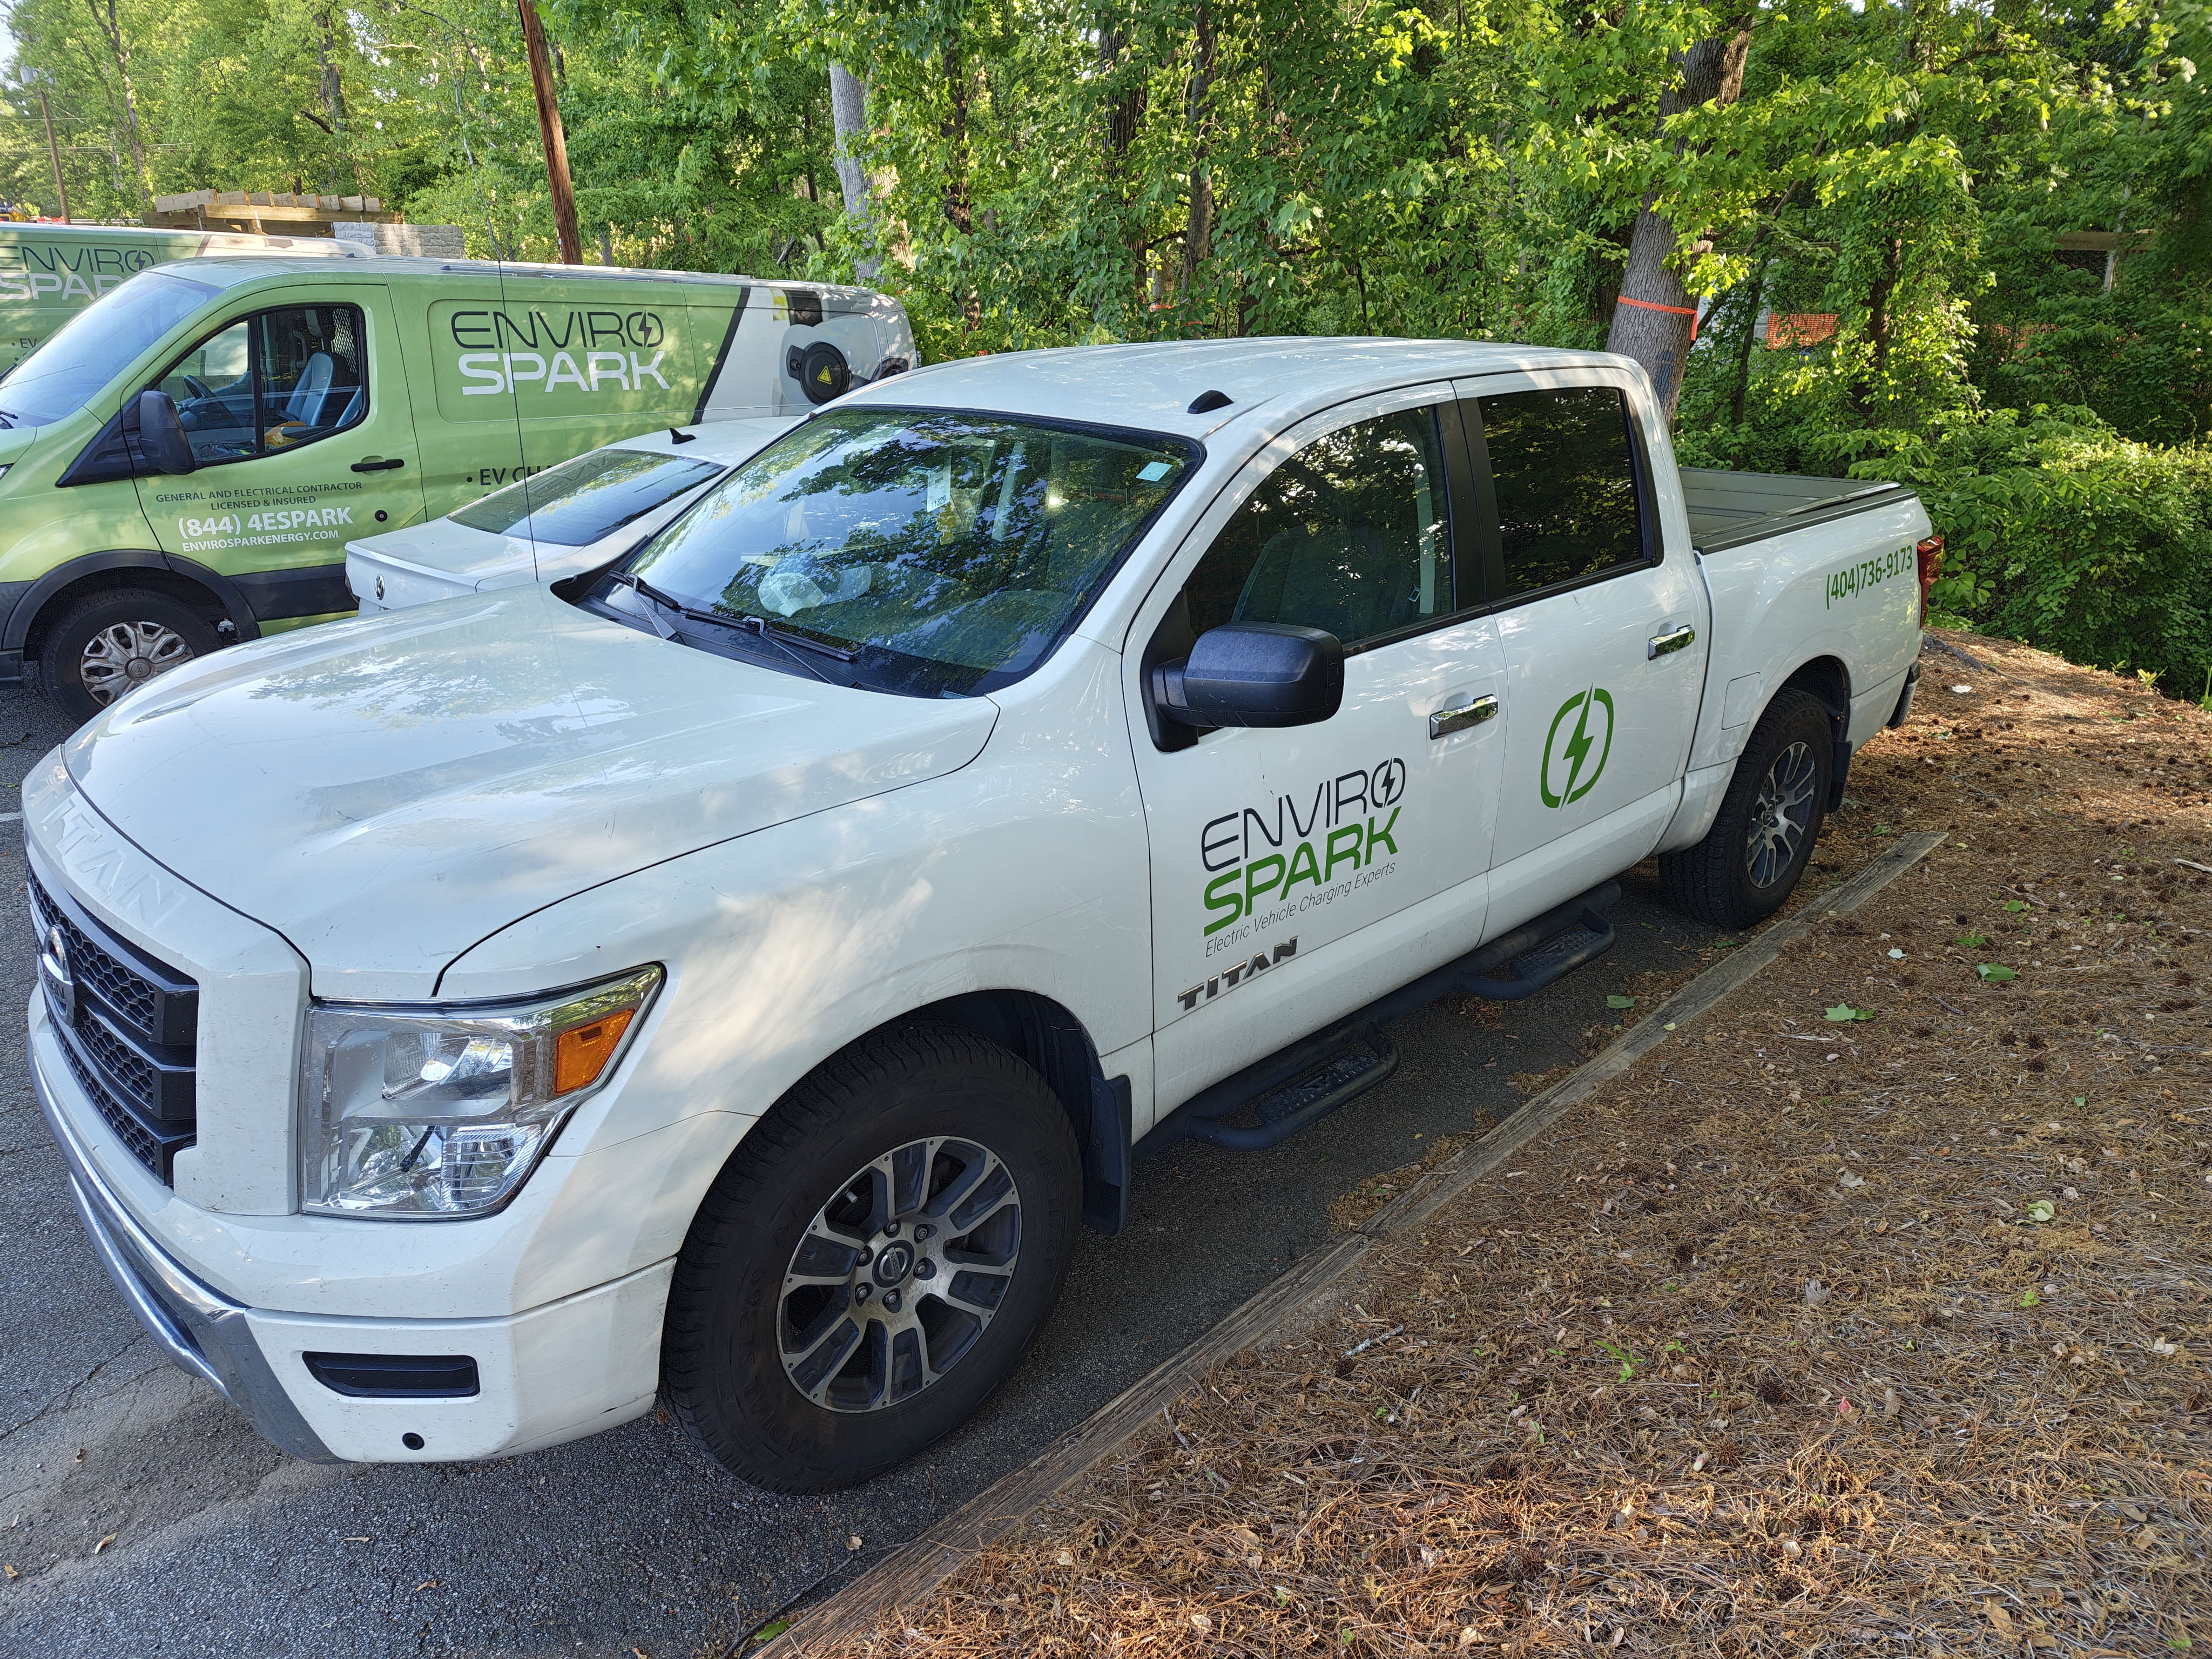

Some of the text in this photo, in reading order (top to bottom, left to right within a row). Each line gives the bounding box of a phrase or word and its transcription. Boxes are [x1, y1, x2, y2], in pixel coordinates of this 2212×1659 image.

[451, 309, 664, 349] ENVIRO
[458, 350, 671, 396] SPARK
[156, 481, 362, 503] GENERAL AND ELECTRICAL CONTRACTOR
[480, 468, 507, 486] EV
[211, 495, 316, 510] LICENSED & INSURED
[931, 495, 946, 509] 11329
[178, 506, 354, 539] (844) 4ESPARK
[182, 530, 339, 552] ENVIROSPARKENERGY.COM
[1826, 544, 1913, 610] (404)736-9173
[1201, 756, 1406, 872] ENVIRO
[1204, 805, 1402, 937] SPARK
[1205, 861, 1396, 958] Electric Vehicle Charging Experts
[1177, 935, 1299, 1011] TITAN
